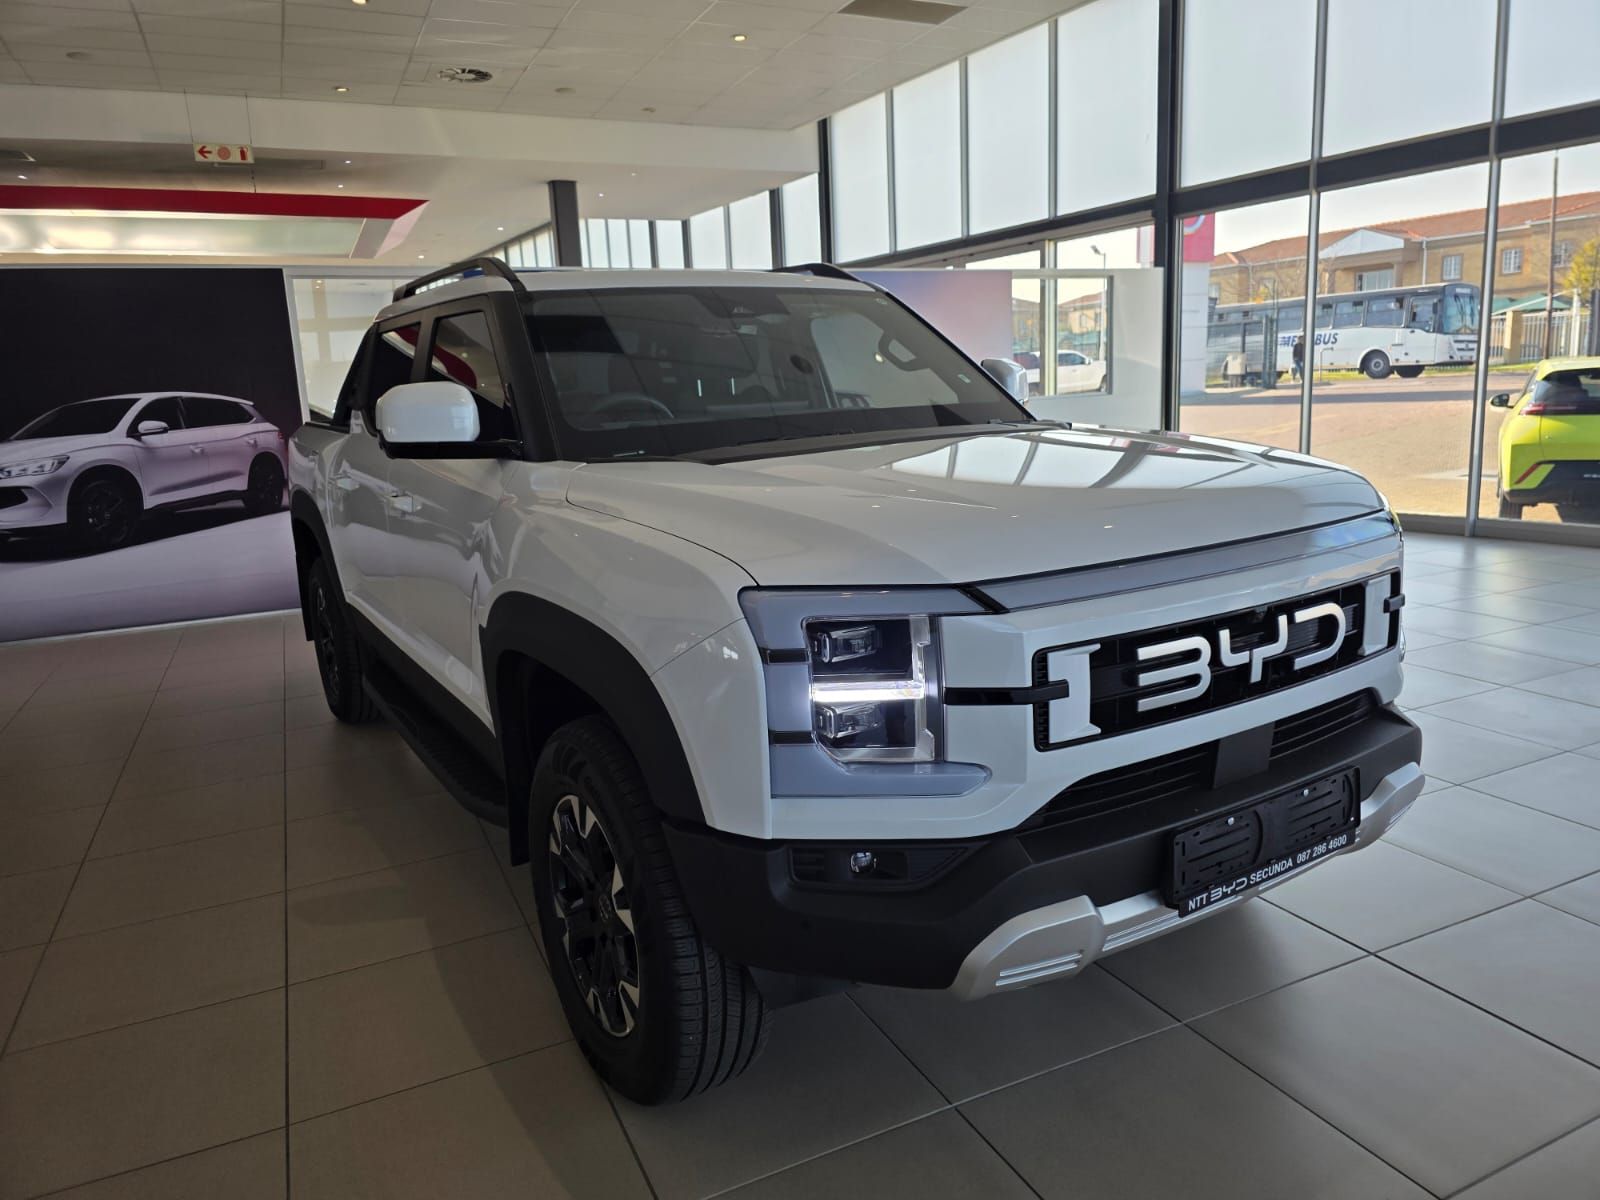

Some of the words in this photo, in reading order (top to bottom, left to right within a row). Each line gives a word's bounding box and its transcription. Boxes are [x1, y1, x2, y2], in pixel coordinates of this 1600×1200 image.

[1136, 602, 1347, 713] BYD
[1188, 893, 1209, 912] NTT
[1210, 877, 1248, 901] BYD
[1250, 857, 1293, 884] SECUNDA
[1296, 849, 1311, 864] 087
[1313, 843, 1327, 857] 286
[1328, 834, 1347, 850] 4600
